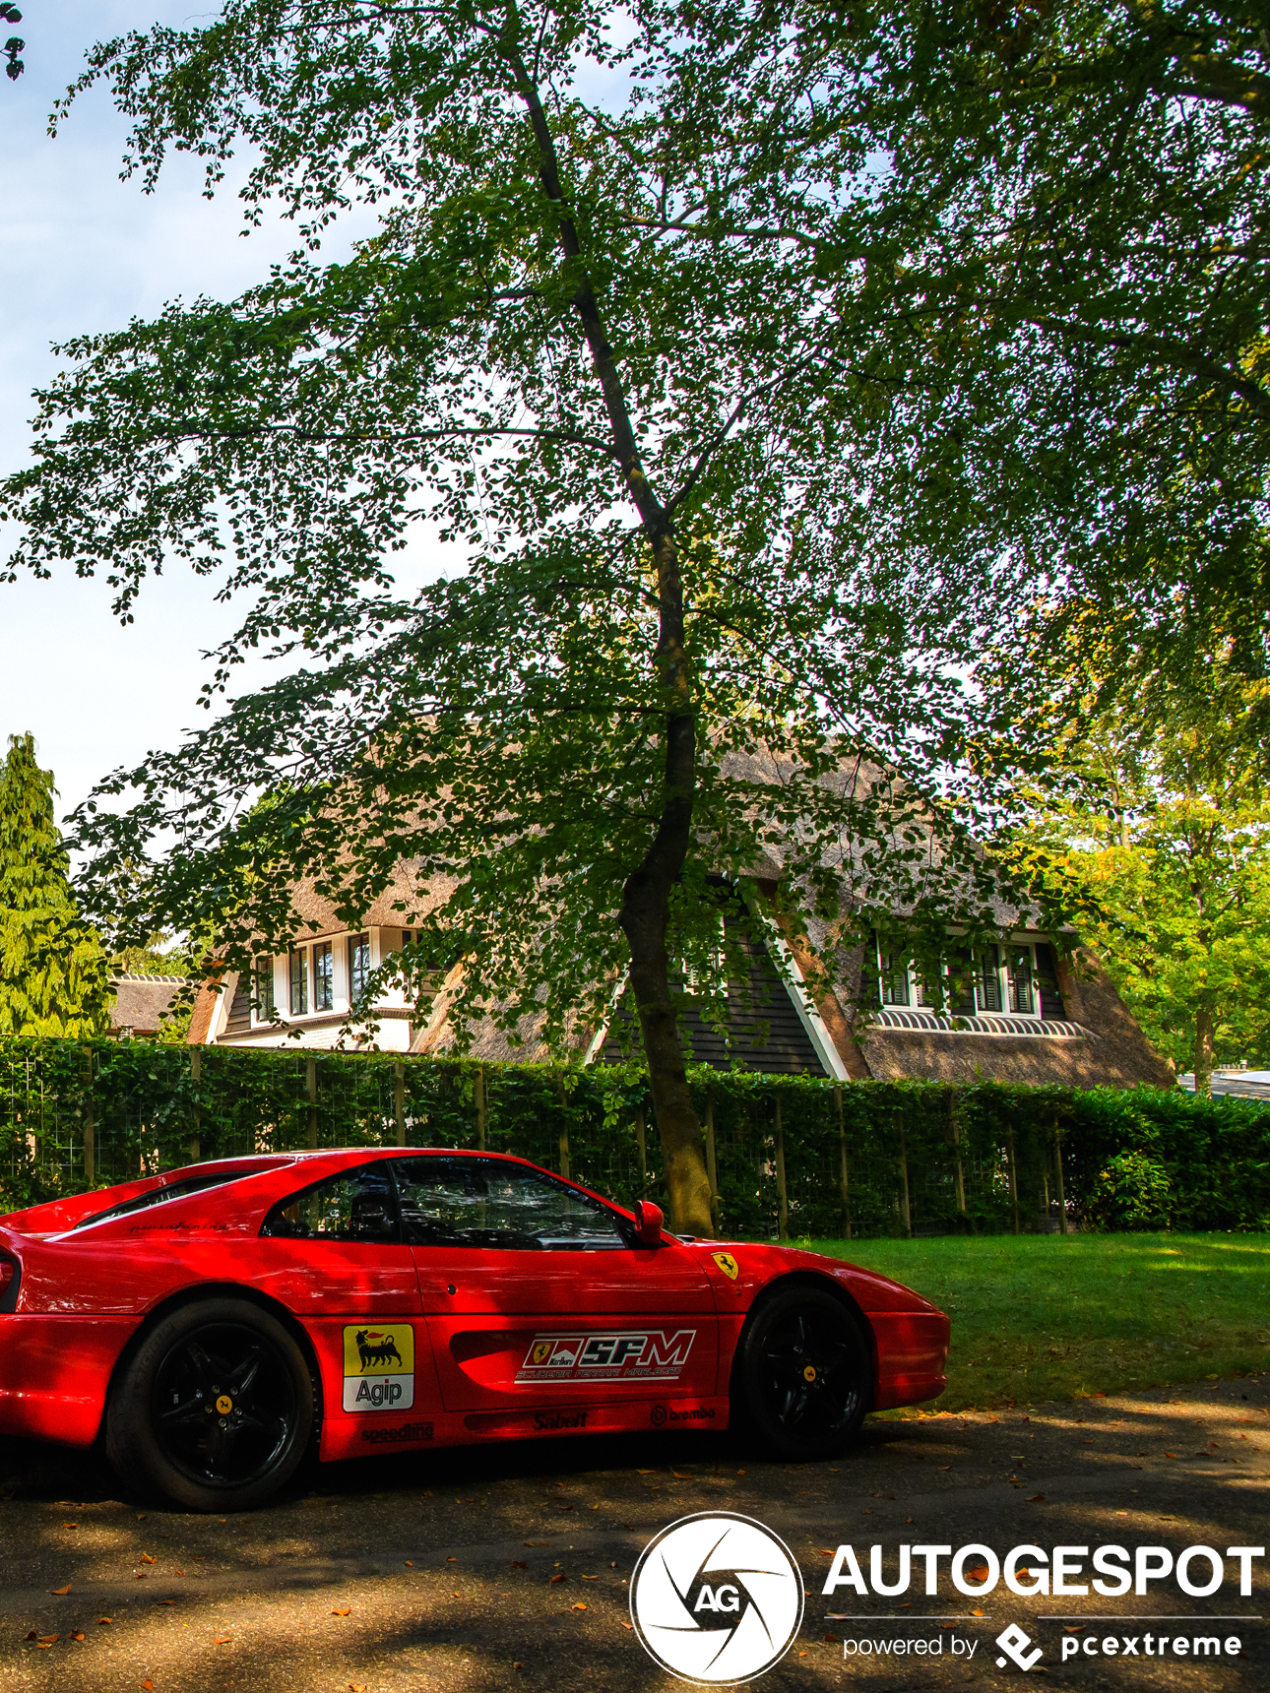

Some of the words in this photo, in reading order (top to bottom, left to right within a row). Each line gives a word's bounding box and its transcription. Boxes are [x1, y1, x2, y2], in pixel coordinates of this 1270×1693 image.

[578, 1330, 697, 1367] SFM
[516, 1369, 573, 1379] SCUDERIA
[575, 1368, 621, 1378] FERRARI
[624, 1366, 683, 1376] MARLBORO
[355, 1379, 403, 1407] Agip
[532, 1411, 589, 1430] Sabelt
[669, 1406, 716, 1421] brembo
[361, 1422, 435, 1443] speedline
